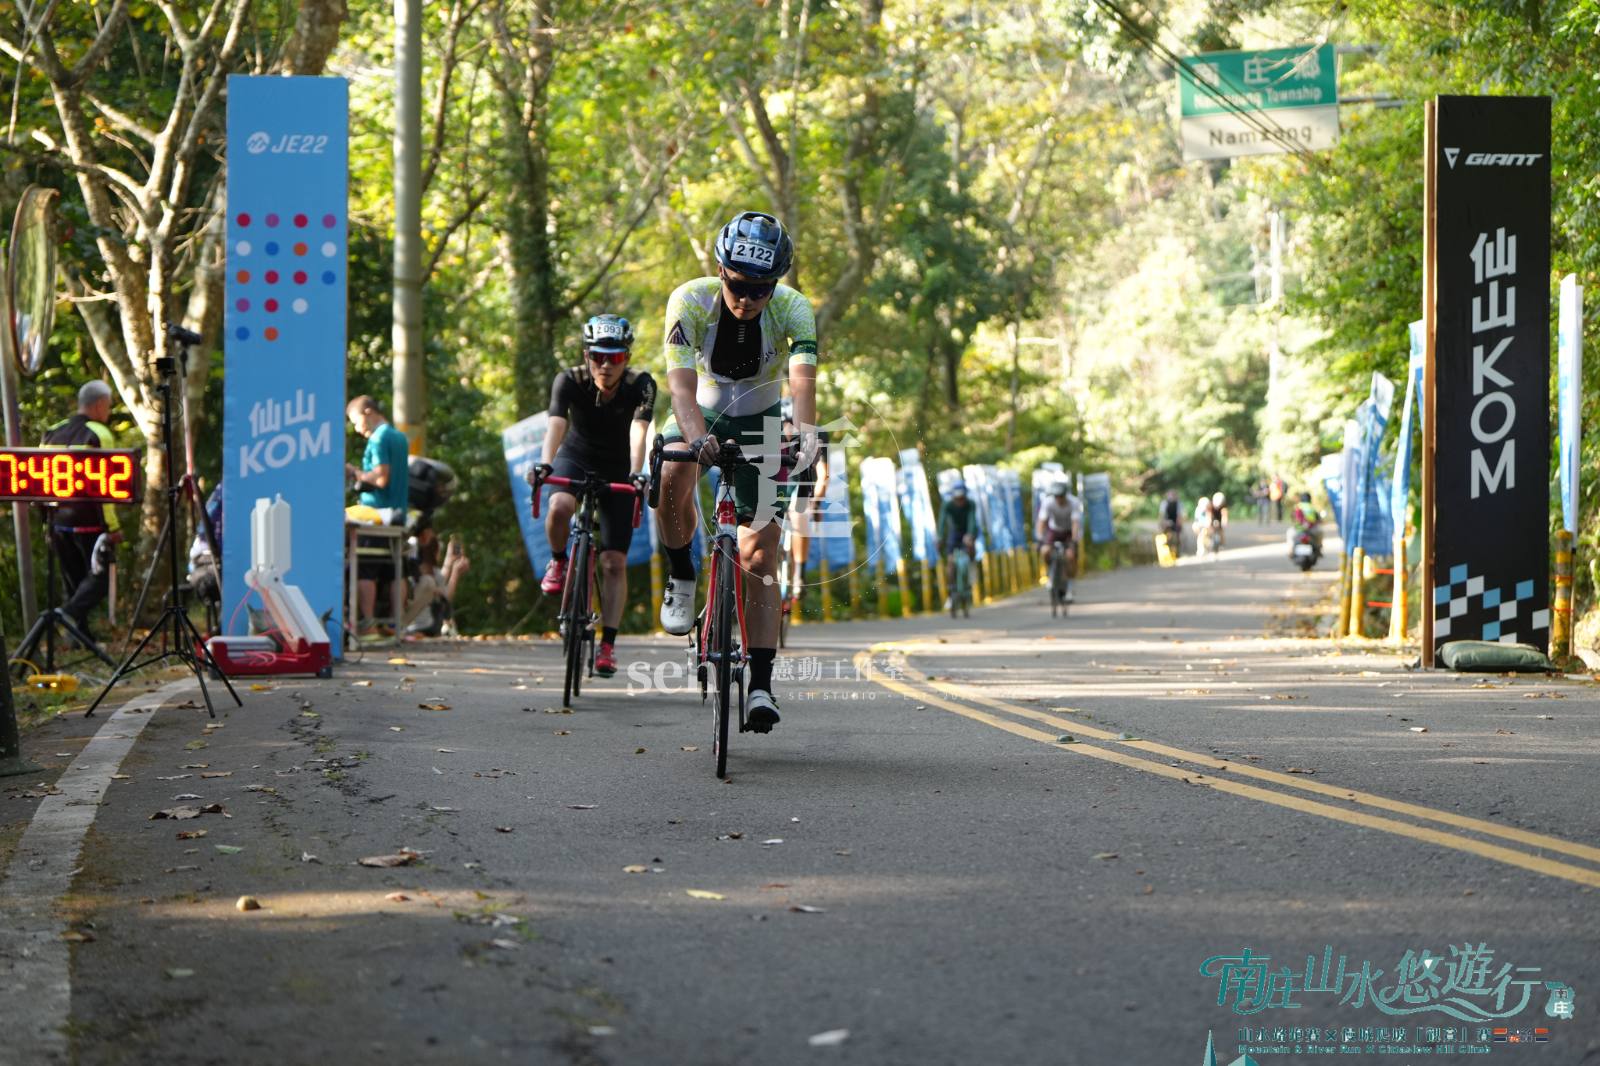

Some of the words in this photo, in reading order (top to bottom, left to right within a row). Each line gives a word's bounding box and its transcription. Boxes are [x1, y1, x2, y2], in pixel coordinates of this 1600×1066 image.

[271, 134, 329, 154] JE22
[1465, 153, 1544, 166] GIANT
[736, 244, 773, 263] 2122
[248, 388, 316, 439] 仙山
[240, 421, 331, 478] KOM
